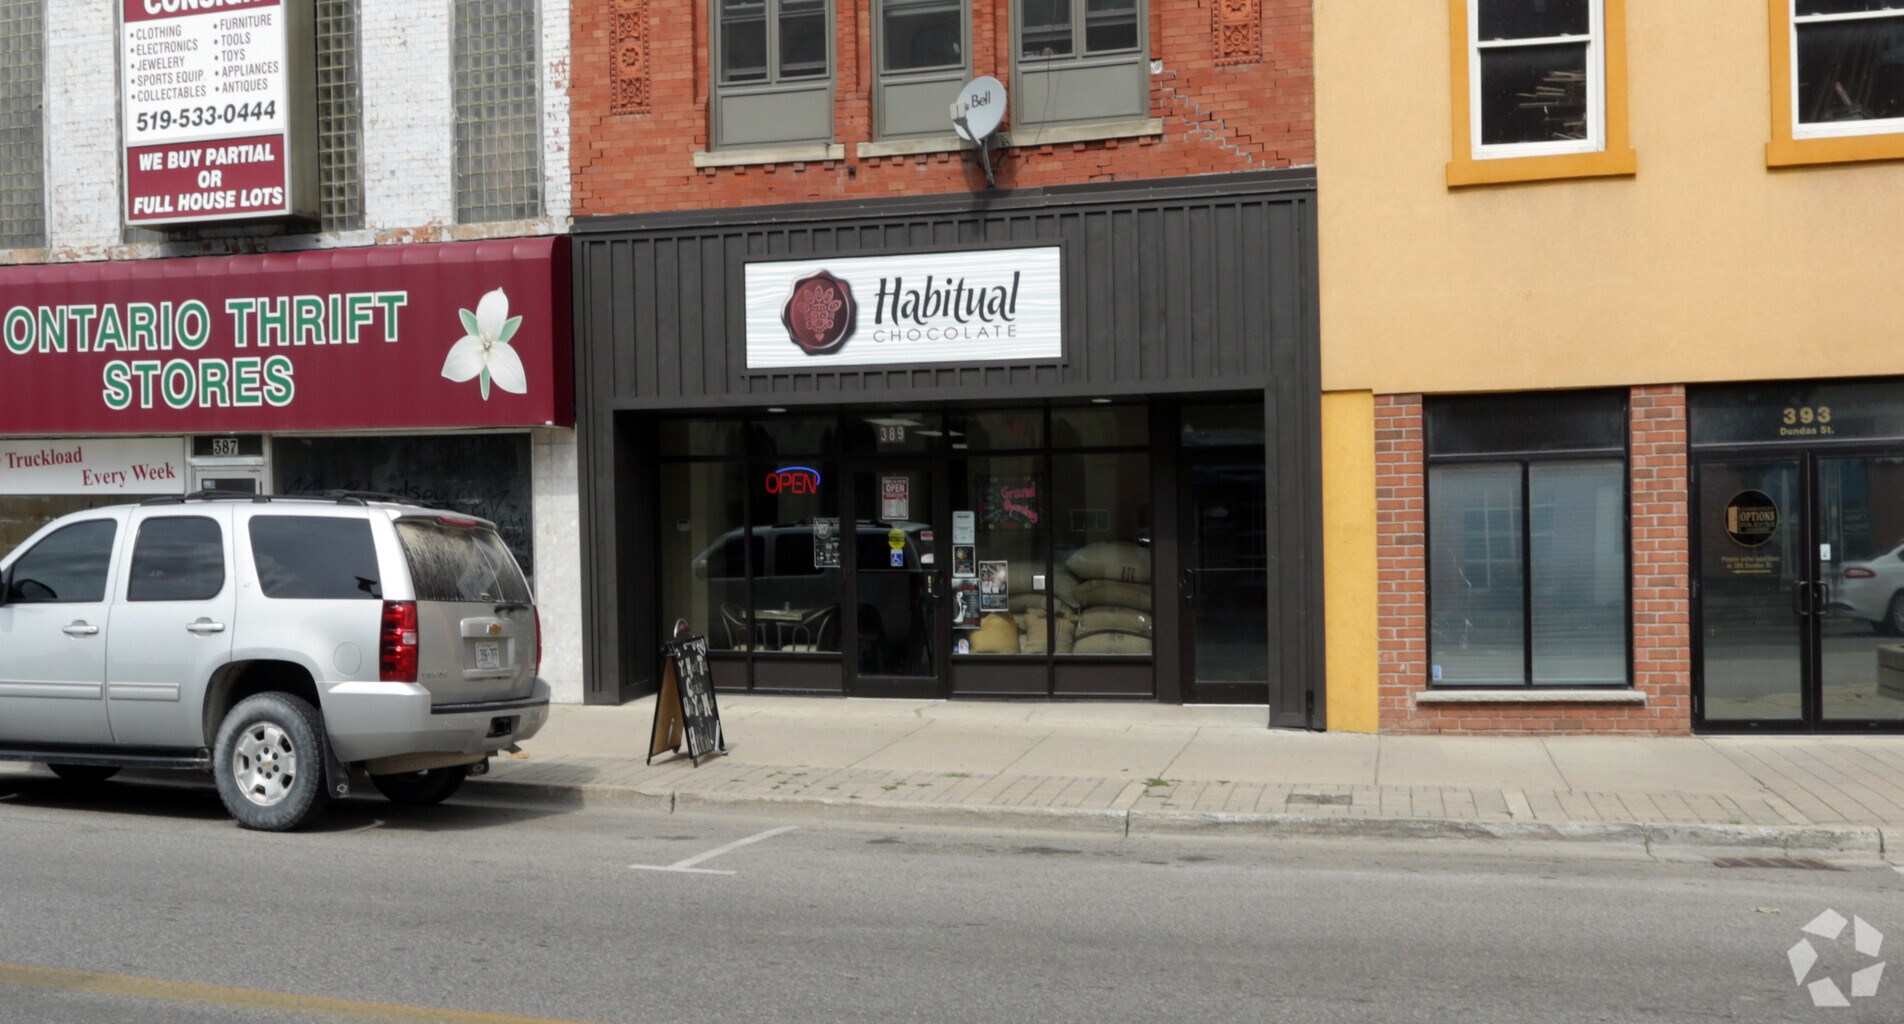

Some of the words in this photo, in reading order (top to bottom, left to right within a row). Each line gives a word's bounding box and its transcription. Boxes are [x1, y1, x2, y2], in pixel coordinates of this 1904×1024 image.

[220, 13, 272, 30] FURNITURE
[136, 25, 182, 41] CLOTHING
[221, 32, 251, 46] TOOLS
[136, 39, 198, 56] ELECTRONICS
[221, 49, 246, 62] TOYS
[137, 56, 185, 71] JEWELERY
[222, 61, 279, 78] APPLIANCES
[137, 72, 173, 87] SPORTS
[176, 70, 206, 83] EQUIP.
[222, 78, 268, 93] ANTIQUES
[137, 85, 206, 102] COLLECTABLES
[971, 90, 991, 108] Bell
[136, 100, 275, 132] 519-533-0444
[139, 152, 163, 171] WE
[167, 149, 202, 169] BUY
[205, 143, 275, 166] PARTIAL
[197, 170, 222, 188] OR
[133, 195, 174, 215] FULL
[177, 190, 237, 211] HOUSE
[240, 186, 283, 207] LOTS
[874, 271, 1020, 326] Habitual
[3, 298, 211, 354] ONTARIO
[225, 290, 408, 348] THRIFT
[872, 324, 1017, 343] CHOCOLATE
[102, 355, 295, 410] STORES
[1783, 406, 1831, 425] 393
[880, 426, 905, 442] 389
[1780, 427, 1817, 436] Dundas
[1820, 425, 1835, 435] St.
[213, 439, 238, 456] 387
[5, 447, 83, 469] Truckload
[82, 469, 127, 487] Every
[132, 462, 176, 481] Week
[765, 472, 817, 494] OPEN
[885, 483, 905, 493] OPEN
[1001, 481, 1036, 499] Grand
[1740, 511, 1776, 523] OPTIONS
